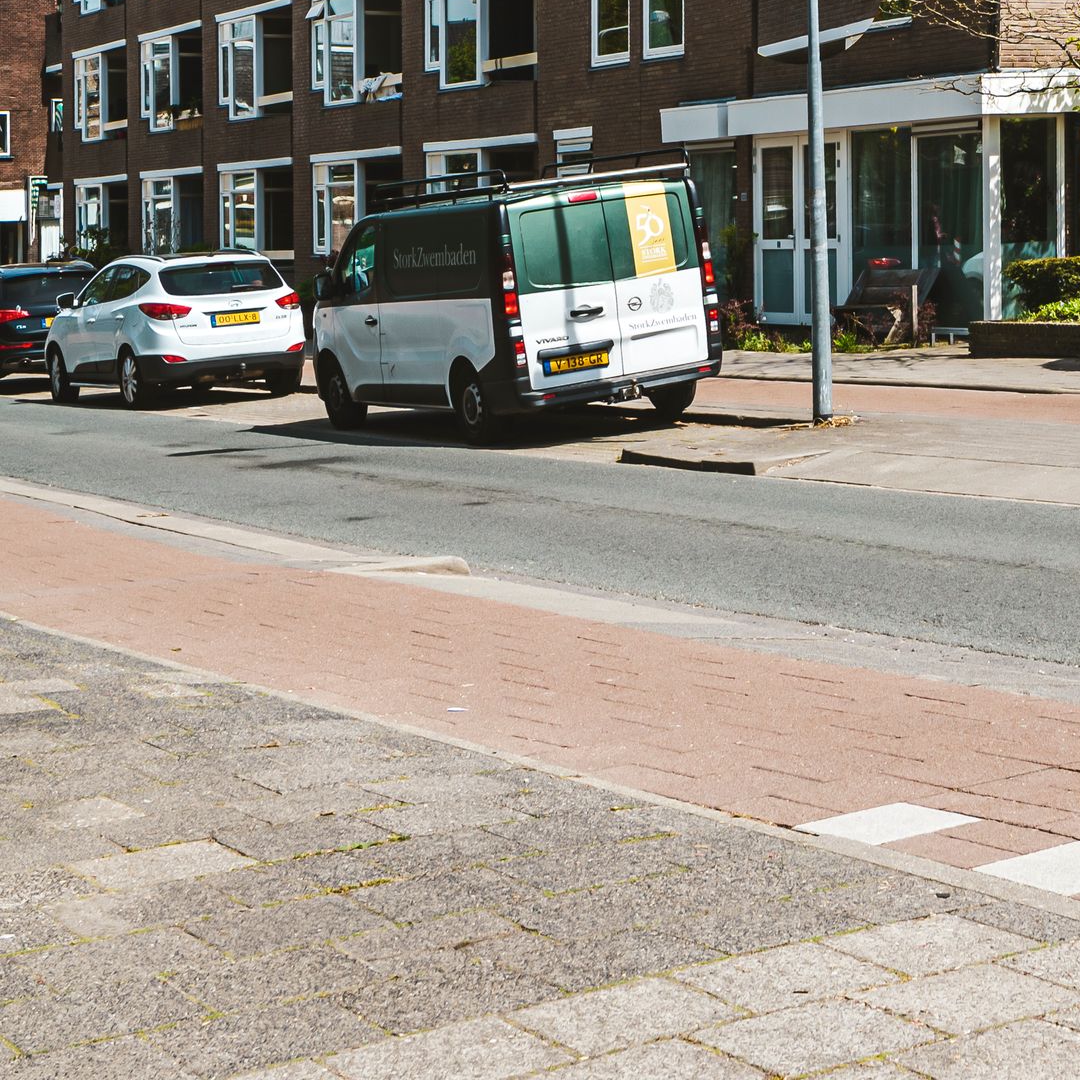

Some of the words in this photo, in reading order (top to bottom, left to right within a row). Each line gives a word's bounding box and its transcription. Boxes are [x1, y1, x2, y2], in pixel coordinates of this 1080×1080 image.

[636, 213, 665, 247] 50
[393, 242, 477, 270] StorkZwembaden
[628, 313, 698, 330] StorkZwembaden
[535, 335, 570, 345] VIVARO
[555, 352, 604, 370] V-138-GR
